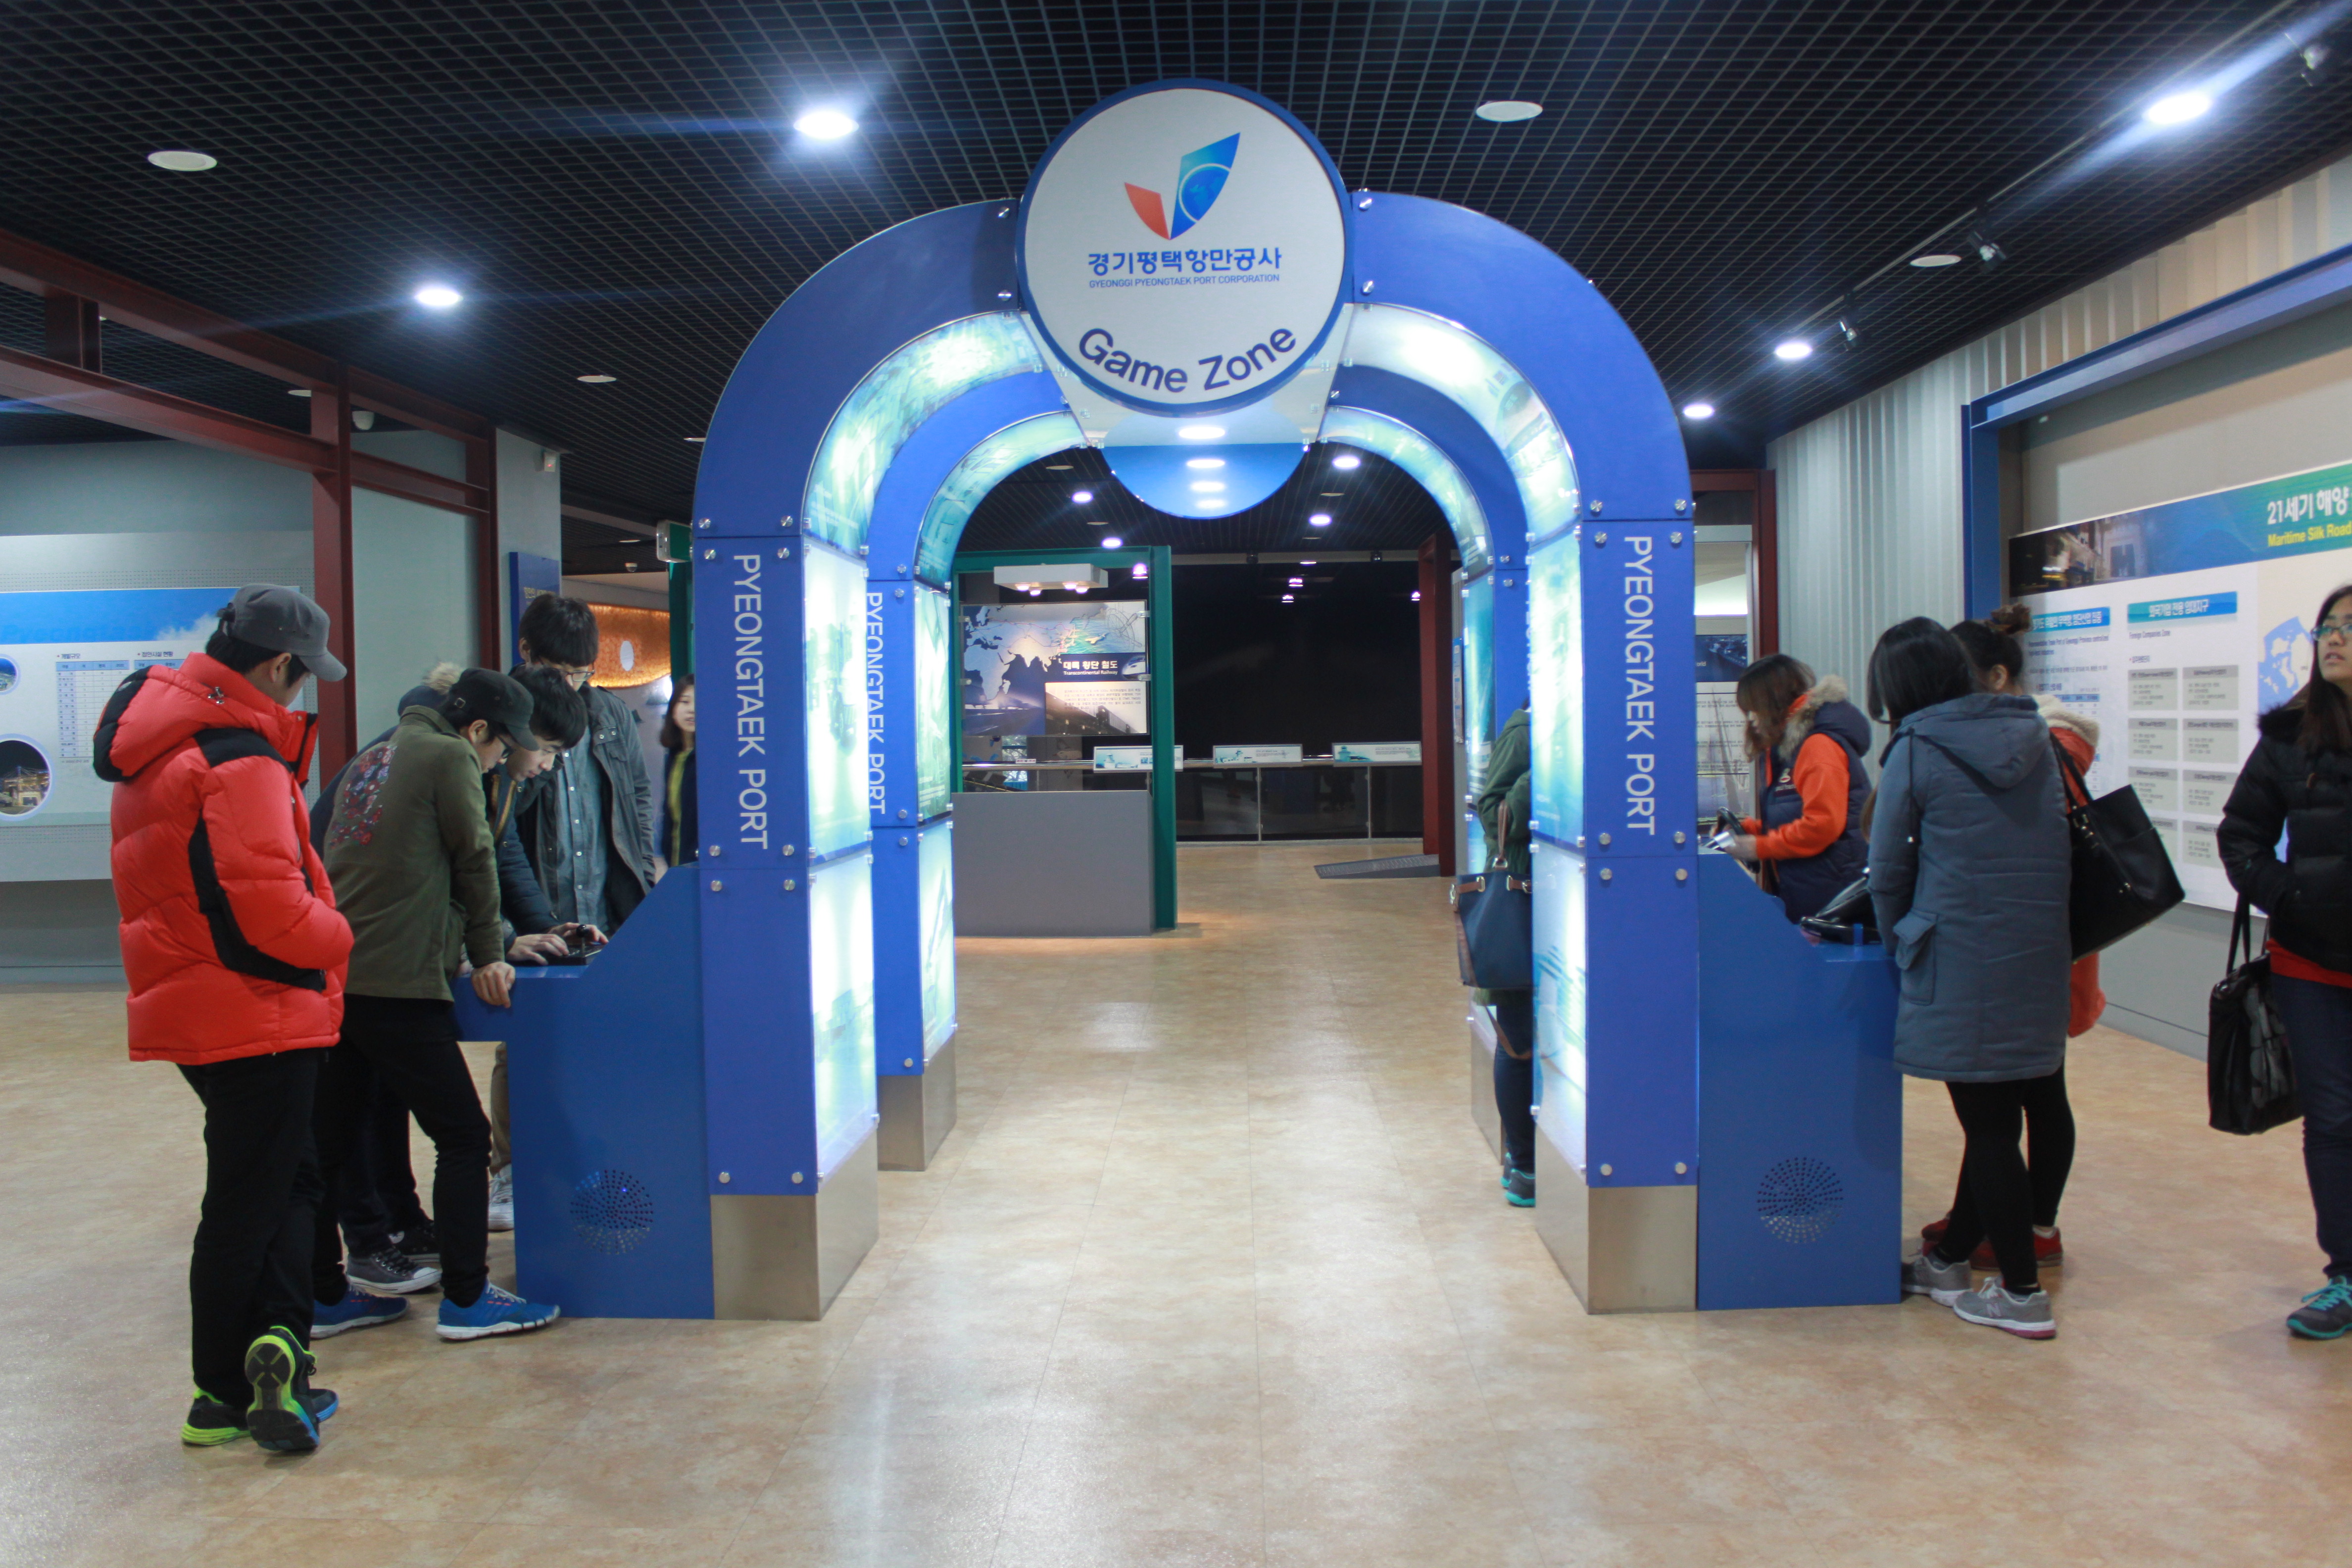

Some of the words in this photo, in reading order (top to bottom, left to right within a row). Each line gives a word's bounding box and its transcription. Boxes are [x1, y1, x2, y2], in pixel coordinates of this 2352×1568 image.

[1088, 247, 1282, 276] 경기평택항만공사
[1089, 279, 1133, 288] GYEONGGI
[1135, 277, 1191, 287] PYEONGTAEK
[1194, 276, 1216, 285] PORT
[1219, 274, 1280, 284] CORPORATION
[1079, 328, 1187, 392] Game
[1198, 329, 1296, 390] Zone
[2267, 493, 2313, 525] 21세기
[2316, 486, 2349, 516] 해양
[2268, 531, 2306, 546] Maritime
[2308, 526, 2325, 540] Silk
[2327, 521, 2352, 537] Road
[734, 555, 766, 757] PYEONGTAEK
[1102, 660, 1118, 669] 철도
[1624, 537, 1654, 741] PYEONGTAEK
[738, 770, 768, 850] PORT
[869, 754, 885, 814] PORT
[1626, 754, 1655, 835] PORT
